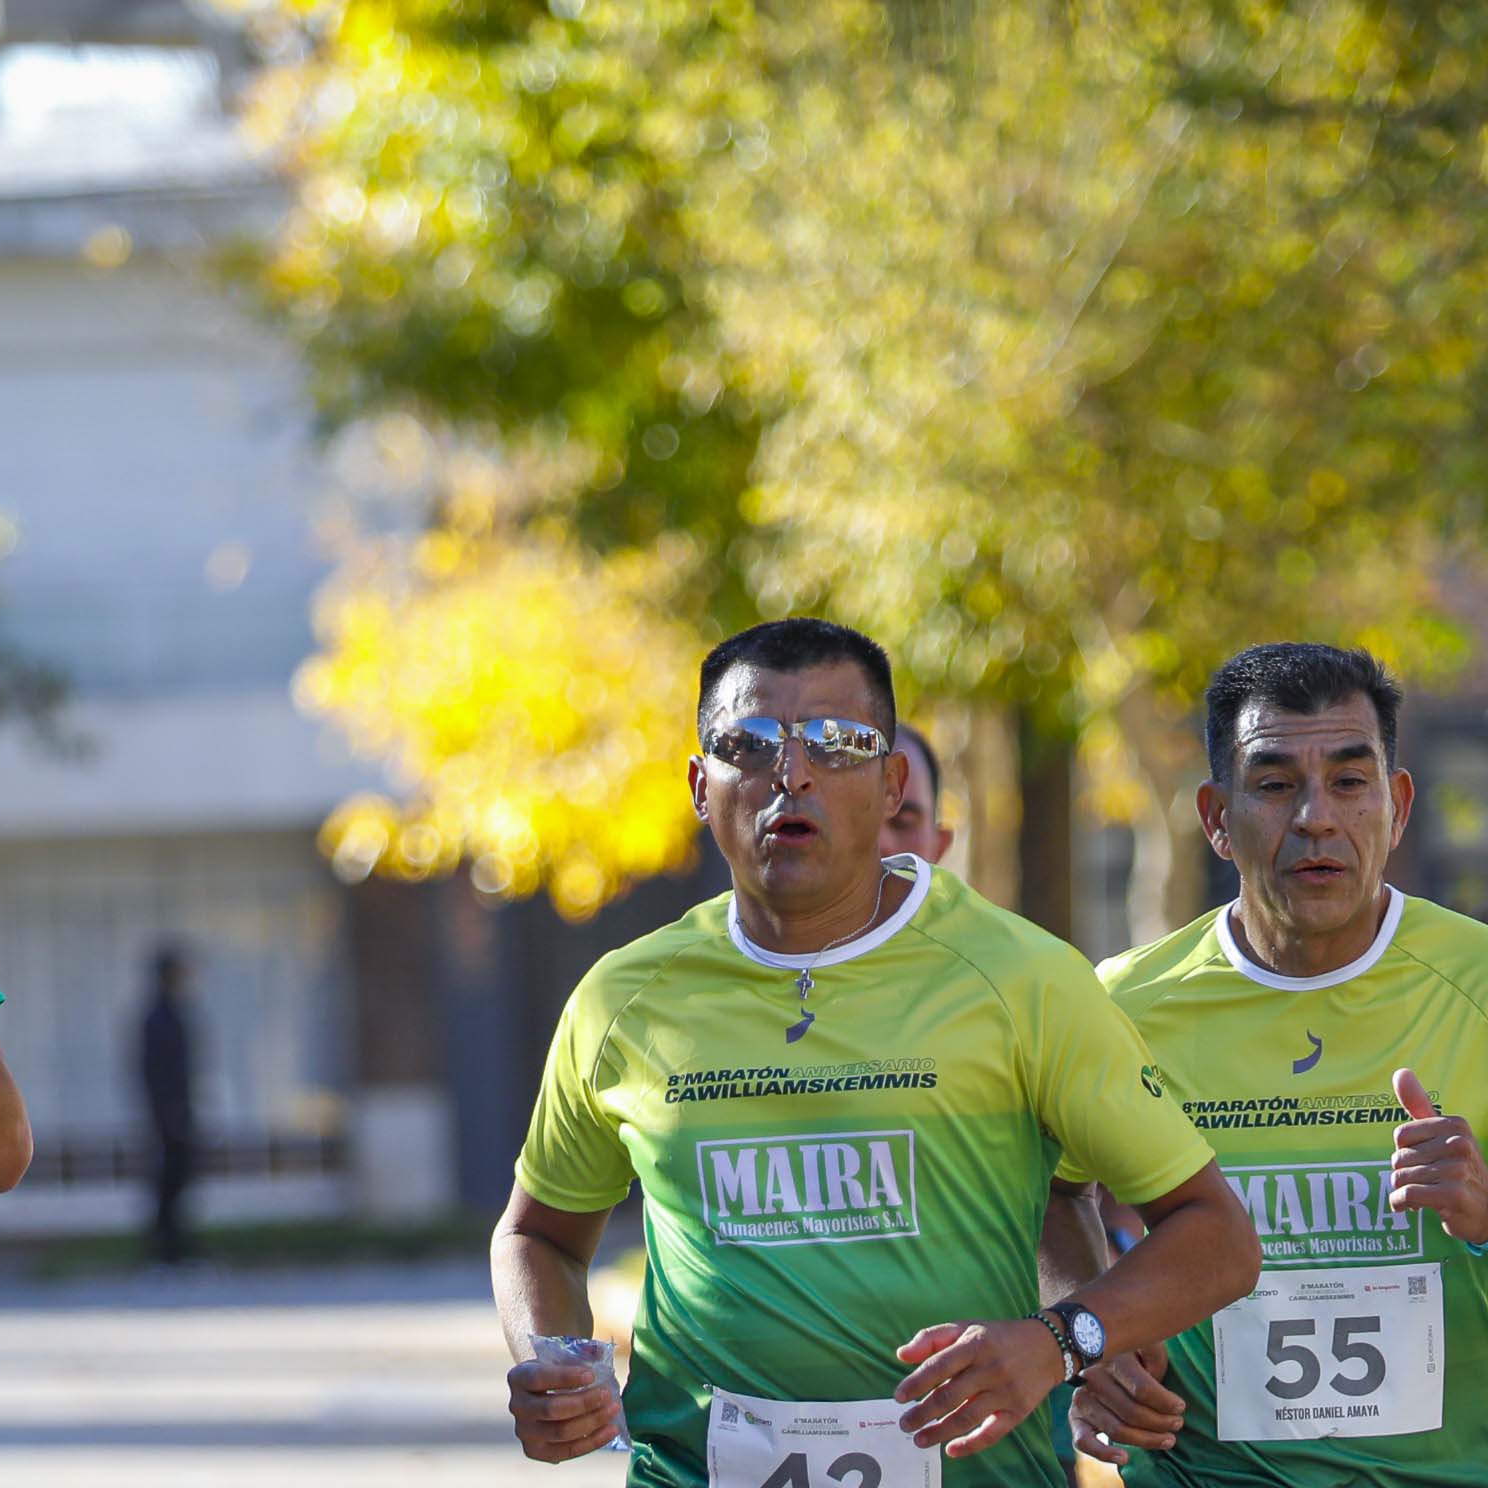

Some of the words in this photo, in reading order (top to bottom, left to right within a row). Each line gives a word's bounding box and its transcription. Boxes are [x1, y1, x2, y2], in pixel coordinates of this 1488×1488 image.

[665, 1072, 939, 1104] CAWILLIAMSKEMMIS
[709, 1141, 904, 1217] MAIRA
[718, 1221, 799, 1238] Almacenes
[802, 1215, 880, 1236] Mayoristas
[882, 1211, 910, 1229] S.A.
[1310, 1236, 1383, 1256] Mayoristas
[1387, 1235, 1411, 1251] S.A.
[1265, 1315, 1387, 1400] 55
[1275, 1406, 1311, 1420] NÉSTOR
[1312, 1406, 1346, 1419] DANIEL
[1347, 1404, 1380, 1418] AMAYA
